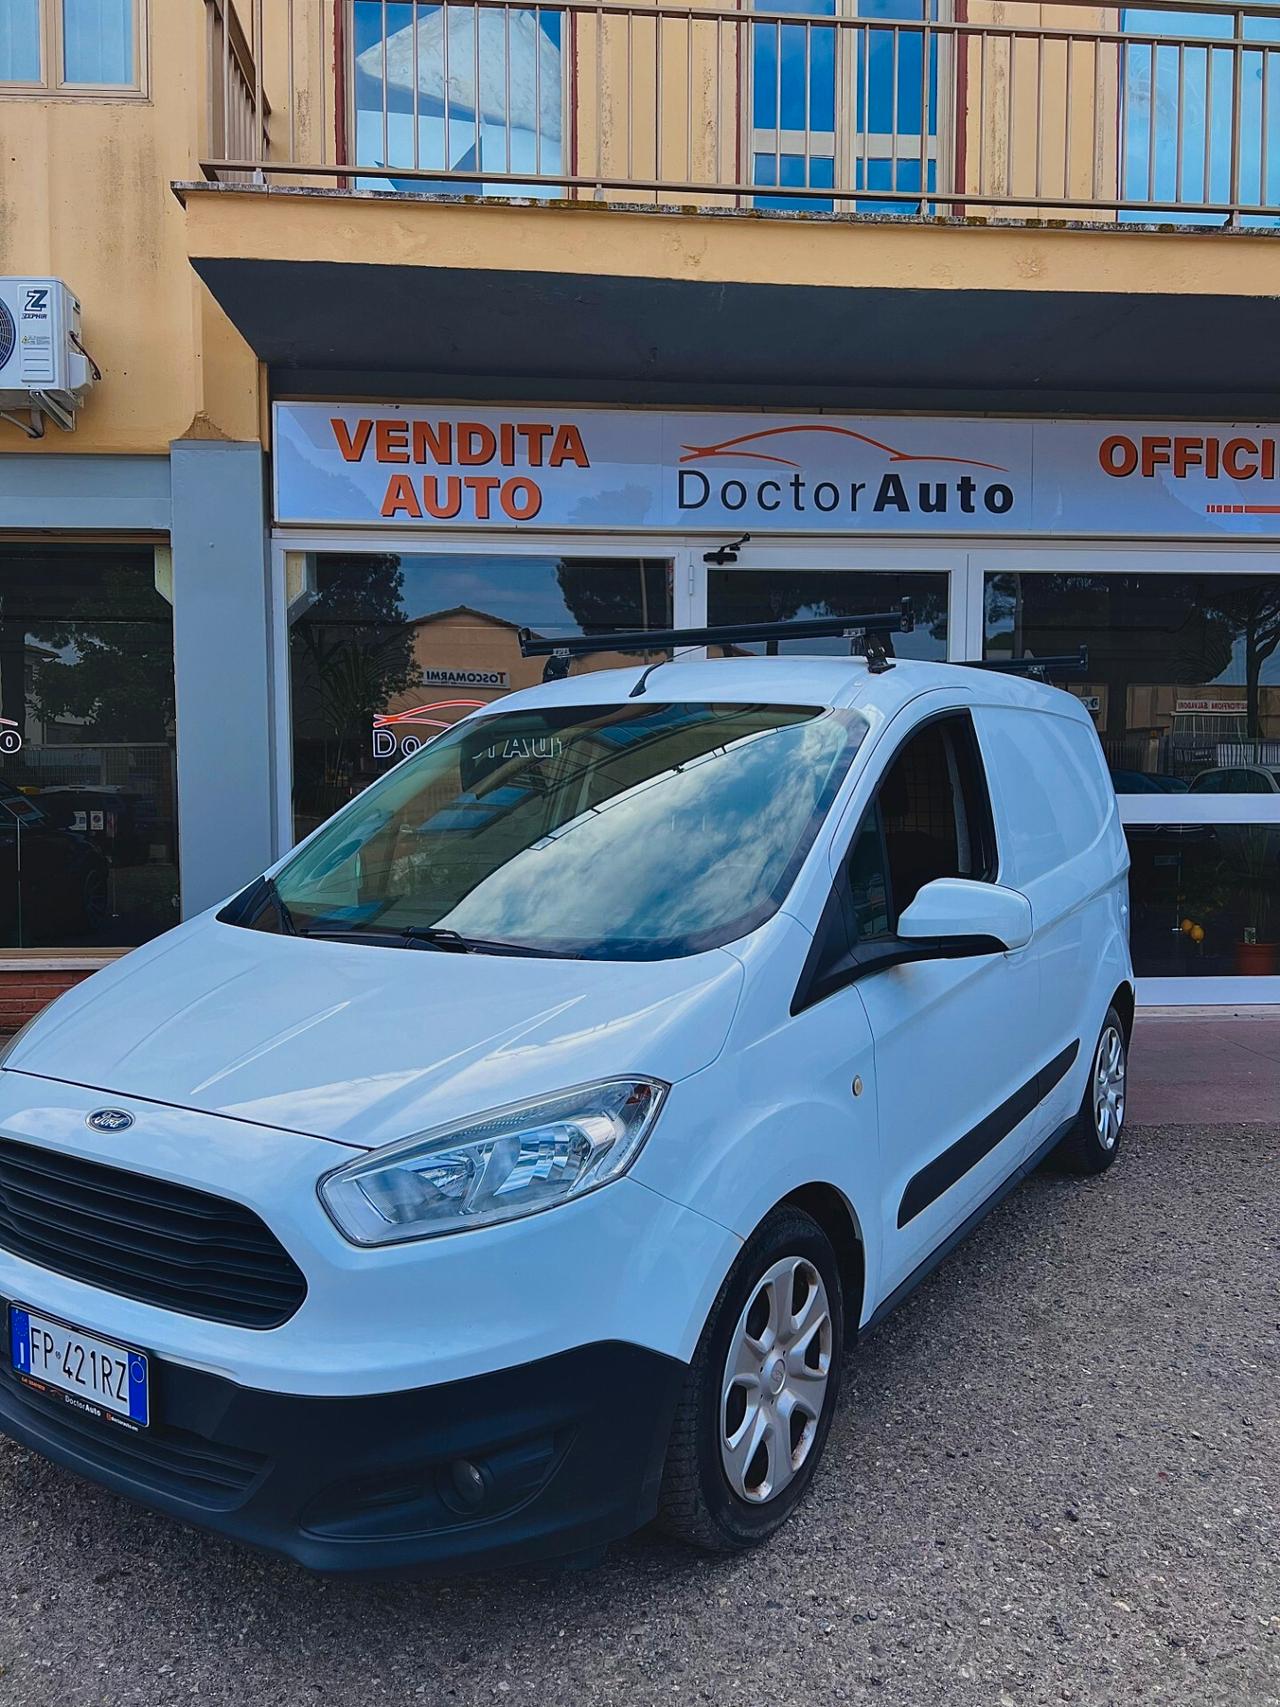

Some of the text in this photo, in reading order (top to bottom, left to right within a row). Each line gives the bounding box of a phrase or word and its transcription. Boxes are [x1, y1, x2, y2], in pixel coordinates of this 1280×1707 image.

[22, 312, 48, 320] ZEPHIR
[330, 418, 590, 468] VENDITA
[1099, 434, 1276, 481] OFFICI
[380, 474, 543, 521] AUTO
[677, 469, 1014, 514] DoctorAuto
